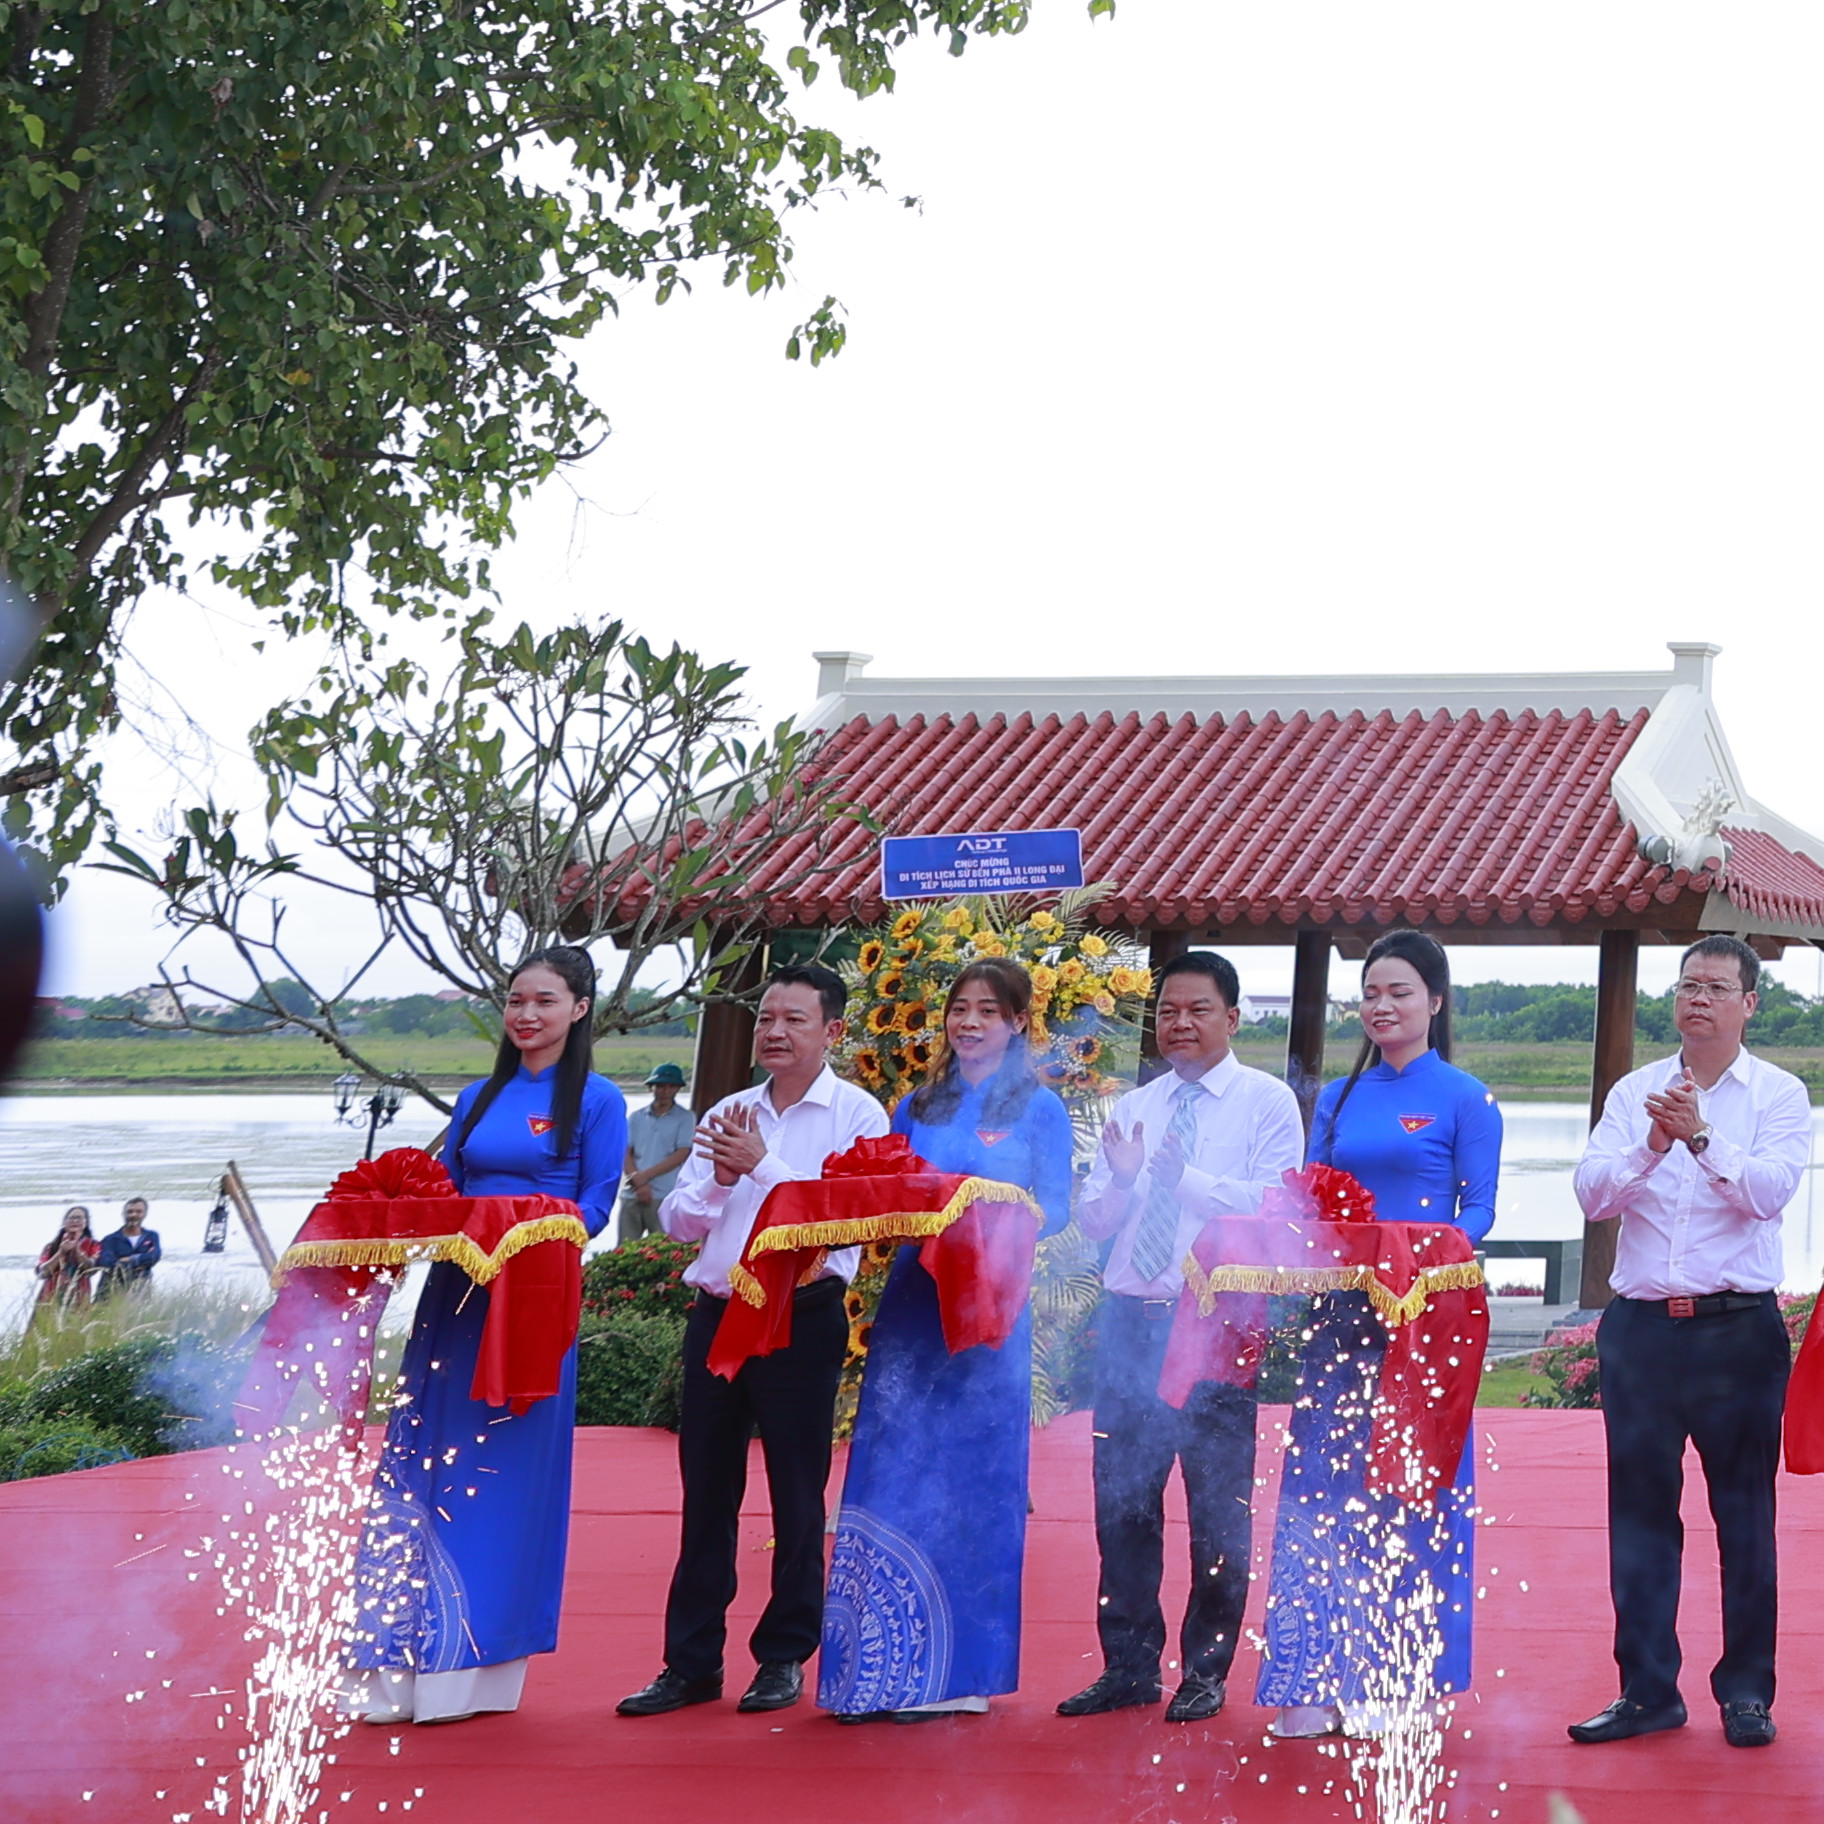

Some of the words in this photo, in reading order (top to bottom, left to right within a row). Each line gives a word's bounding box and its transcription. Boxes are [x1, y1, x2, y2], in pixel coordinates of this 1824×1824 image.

[957, 838, 1007, 851] ADT
[911, 871, 932, 881] TÍCH
[1023, 866, 1047, 875] LONG
[979, 877, 1000, 887] TÍCH
[1030, 875, 1046, 884] GIA
